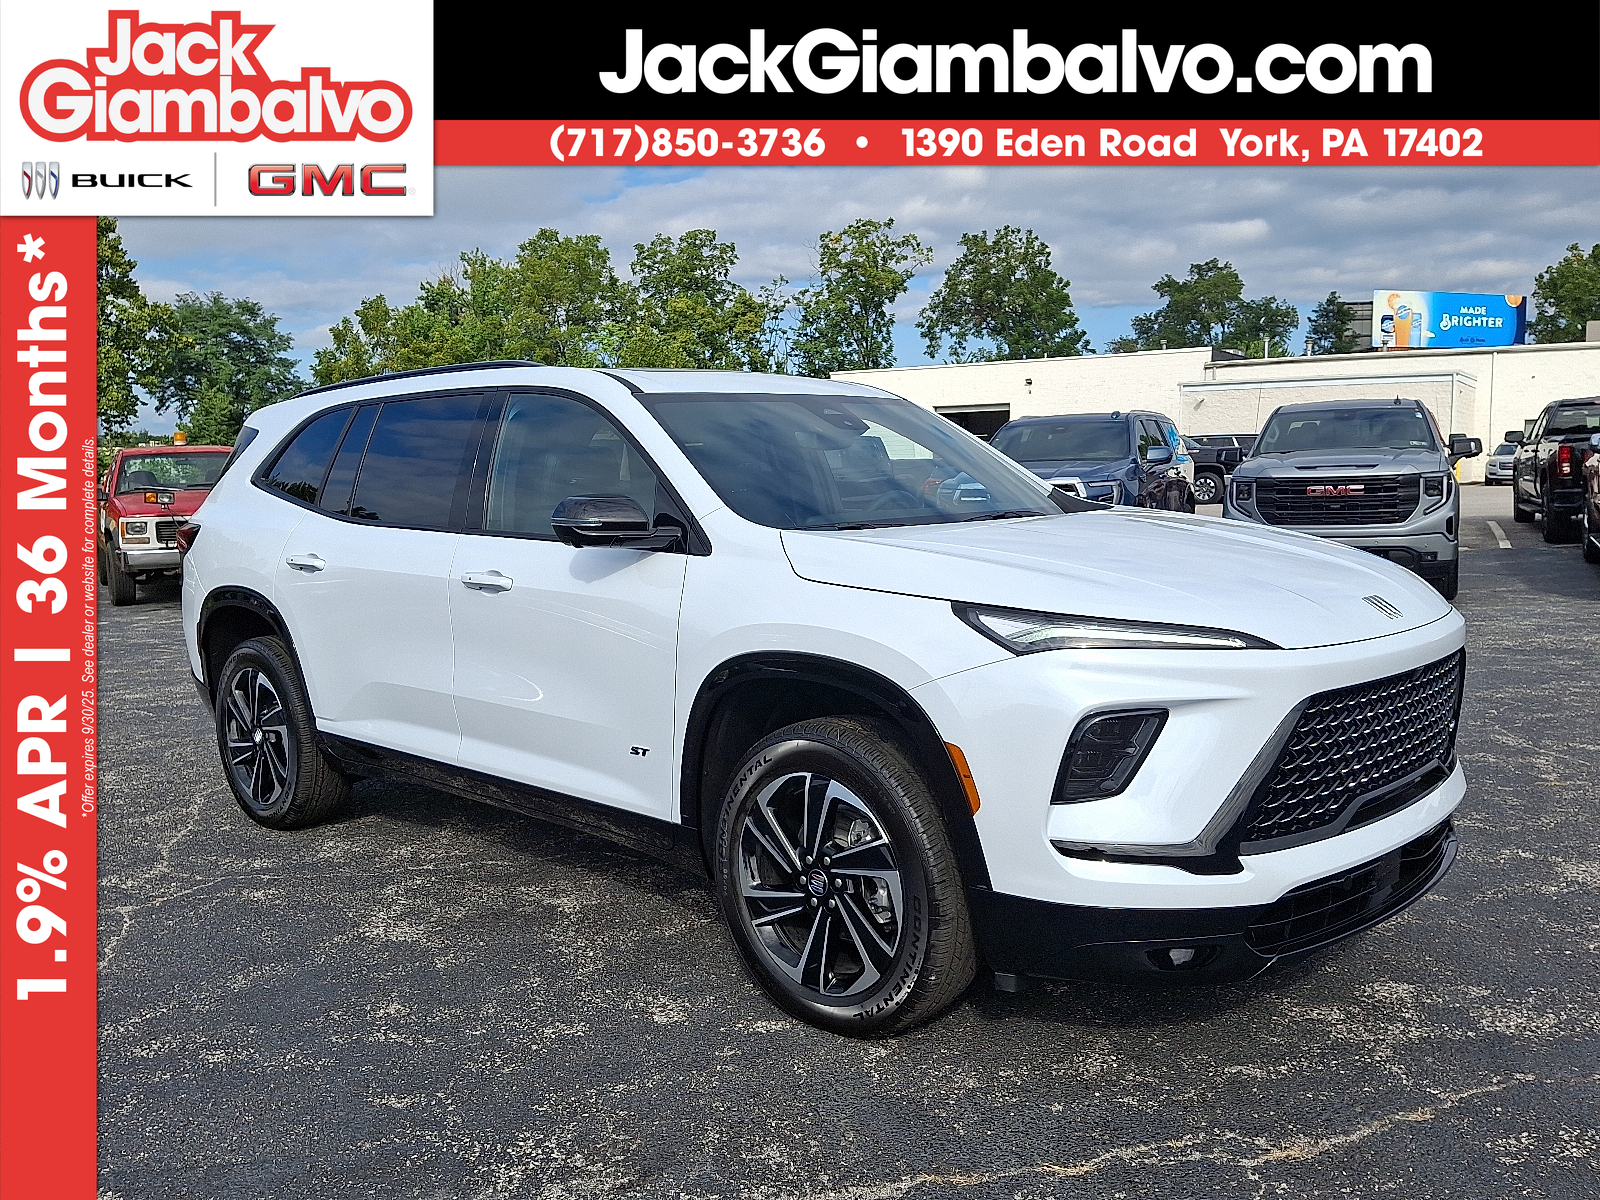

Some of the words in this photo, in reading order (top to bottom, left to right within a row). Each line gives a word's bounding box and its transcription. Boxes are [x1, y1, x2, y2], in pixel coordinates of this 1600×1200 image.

[1459, 305, 1487, 315] MADE
[1439, 313, 1503, 331] BRIGHTER
[1306, 484, 1365, 497] GMC
[629, 745, 651, 757] ST
[718, 754, 773, 864] NTINENTAL
[852, 894, 922, 1020] CONTINENTAL
